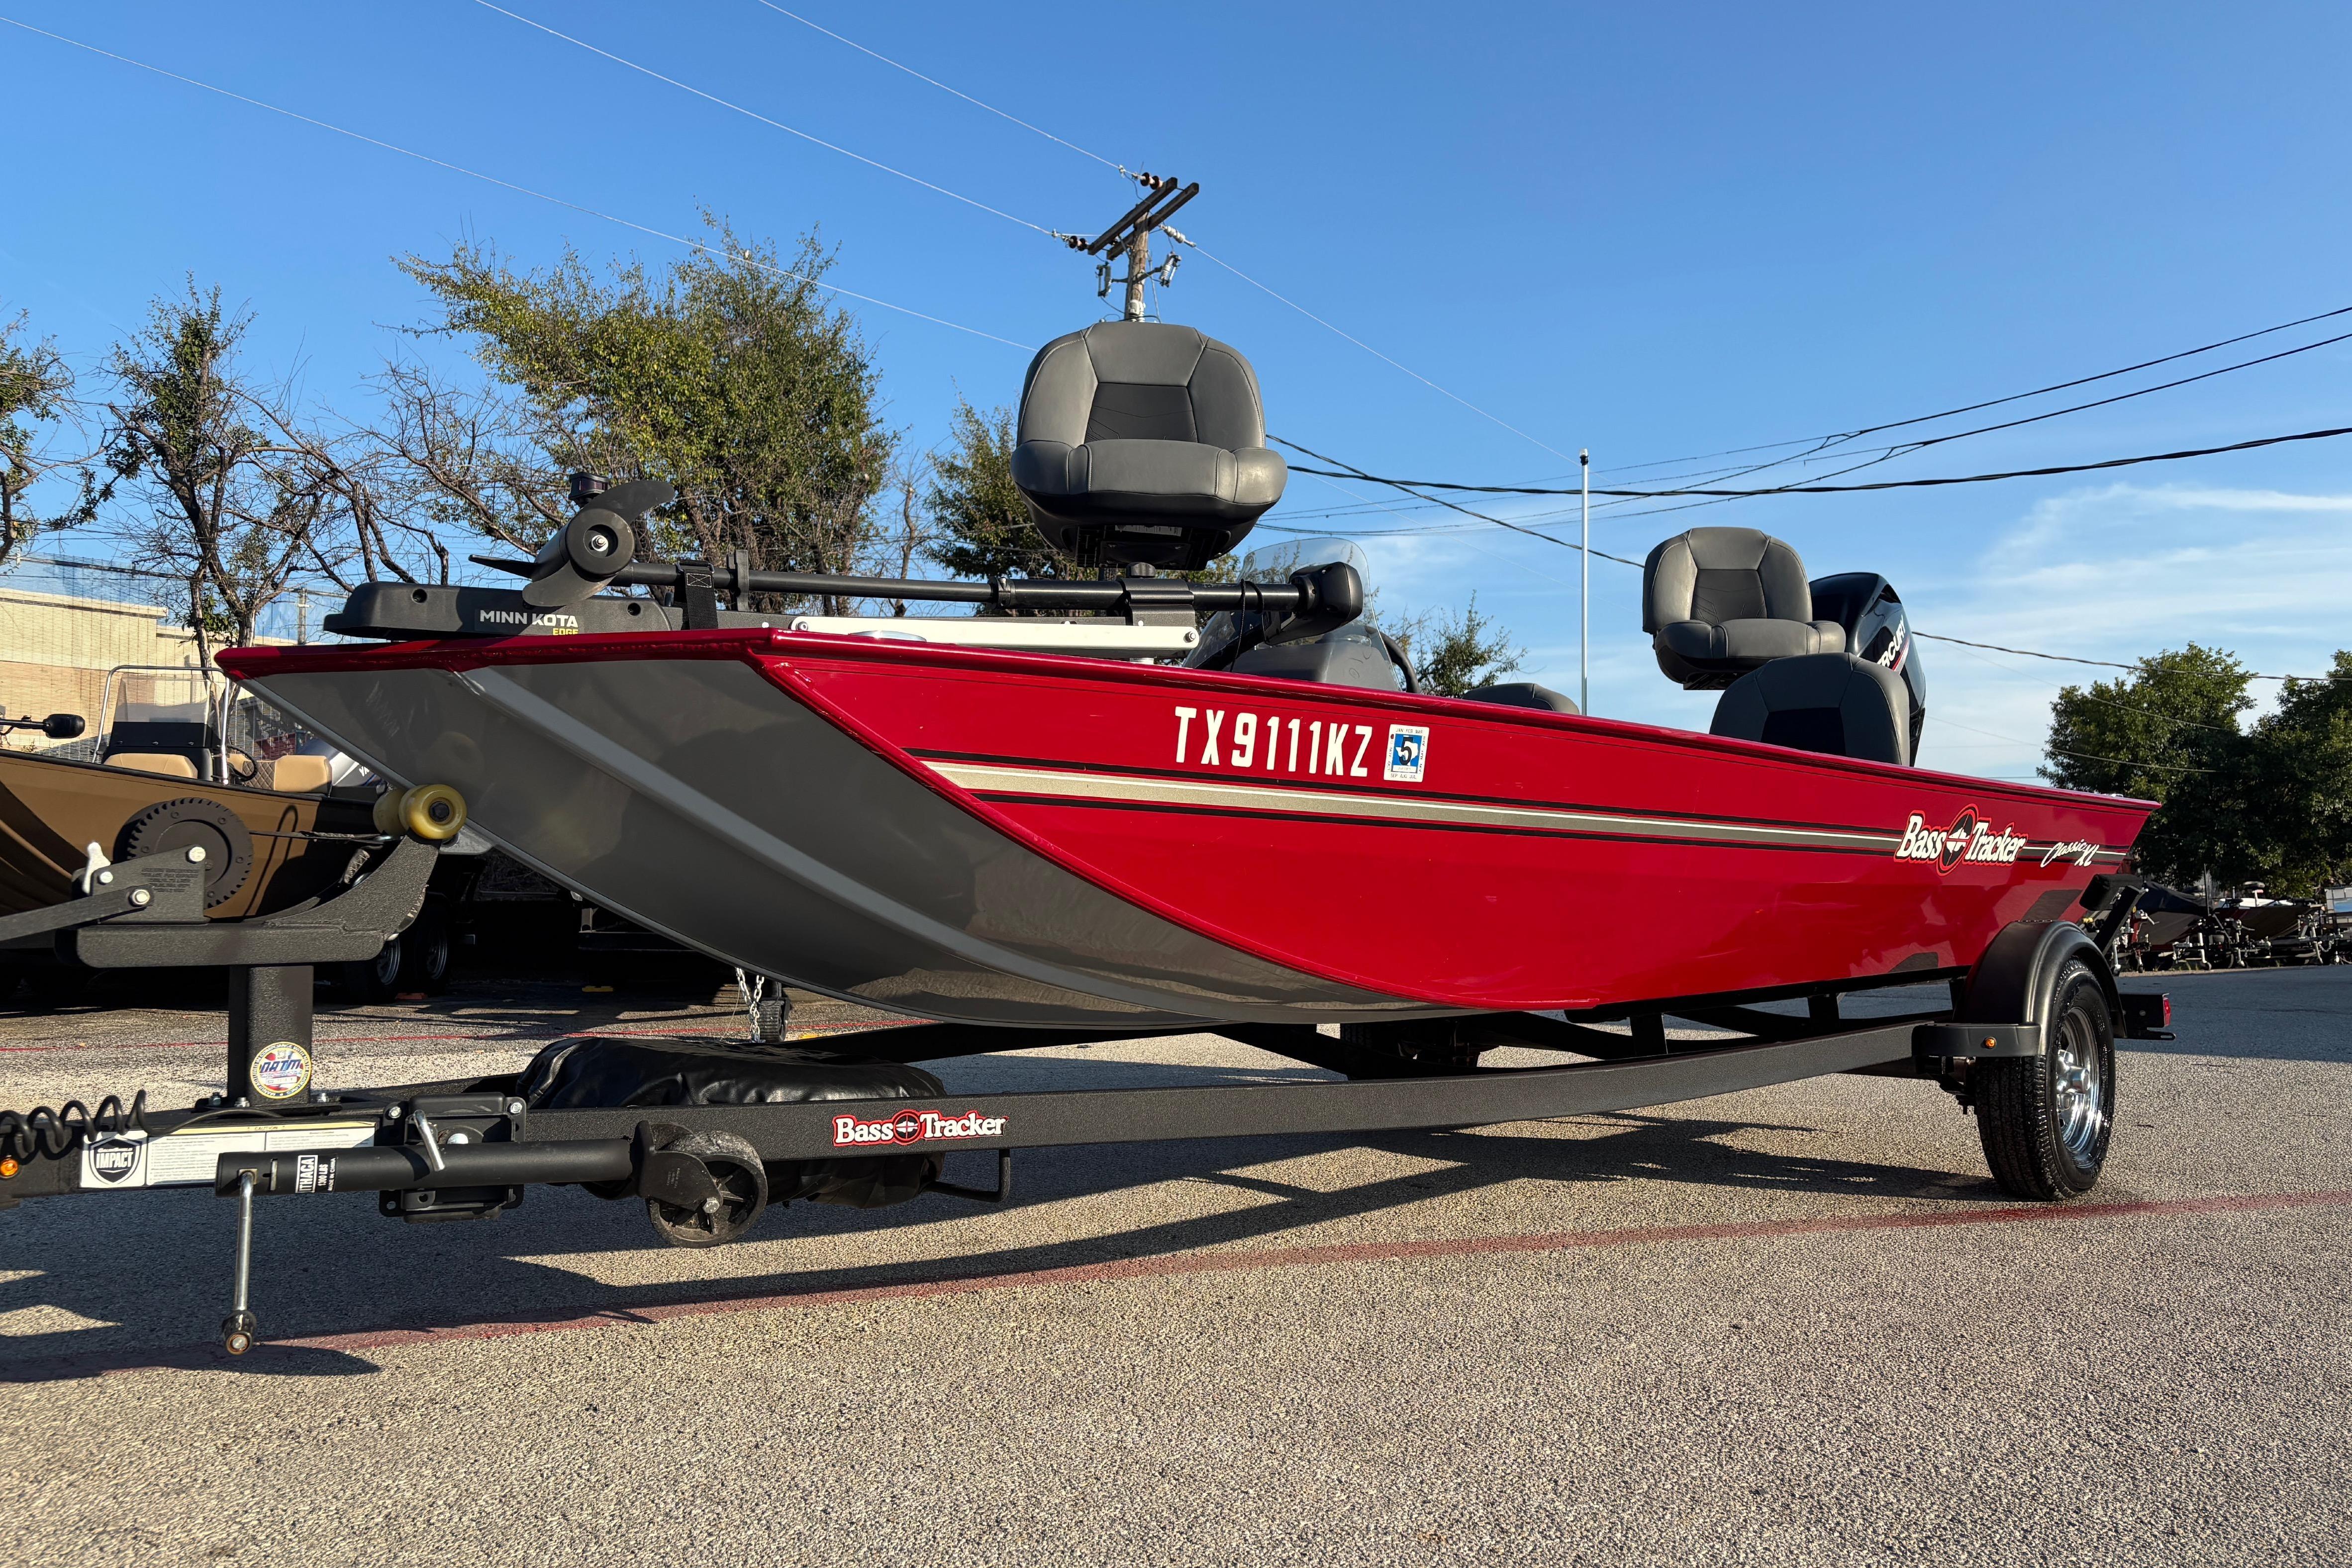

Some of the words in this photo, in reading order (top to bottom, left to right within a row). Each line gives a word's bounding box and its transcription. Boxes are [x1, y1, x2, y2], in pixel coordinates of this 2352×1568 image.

[480, 610, 527, 624] MINN
[532, 613, 579, 627] KOTA
[1399, 737, 1413, 766] 5
[1896, 815, 1947, 860] Bass
[1965, 821, 2026, 863] Tracker
[2040, 839, 2087, 868] Classic
[2074, 844, 2100, 867] XL
[259, 1059, 301, 1074] NATM
[835, 1117, 894, 1144] Bass
[919, 1112, 1006, 1138] Tracker
[96, 1152, 133, 1169] IMPACT
[318, 1164, 328, 1175] LBS
[299, 1158, 315, 1191] ITHACA
